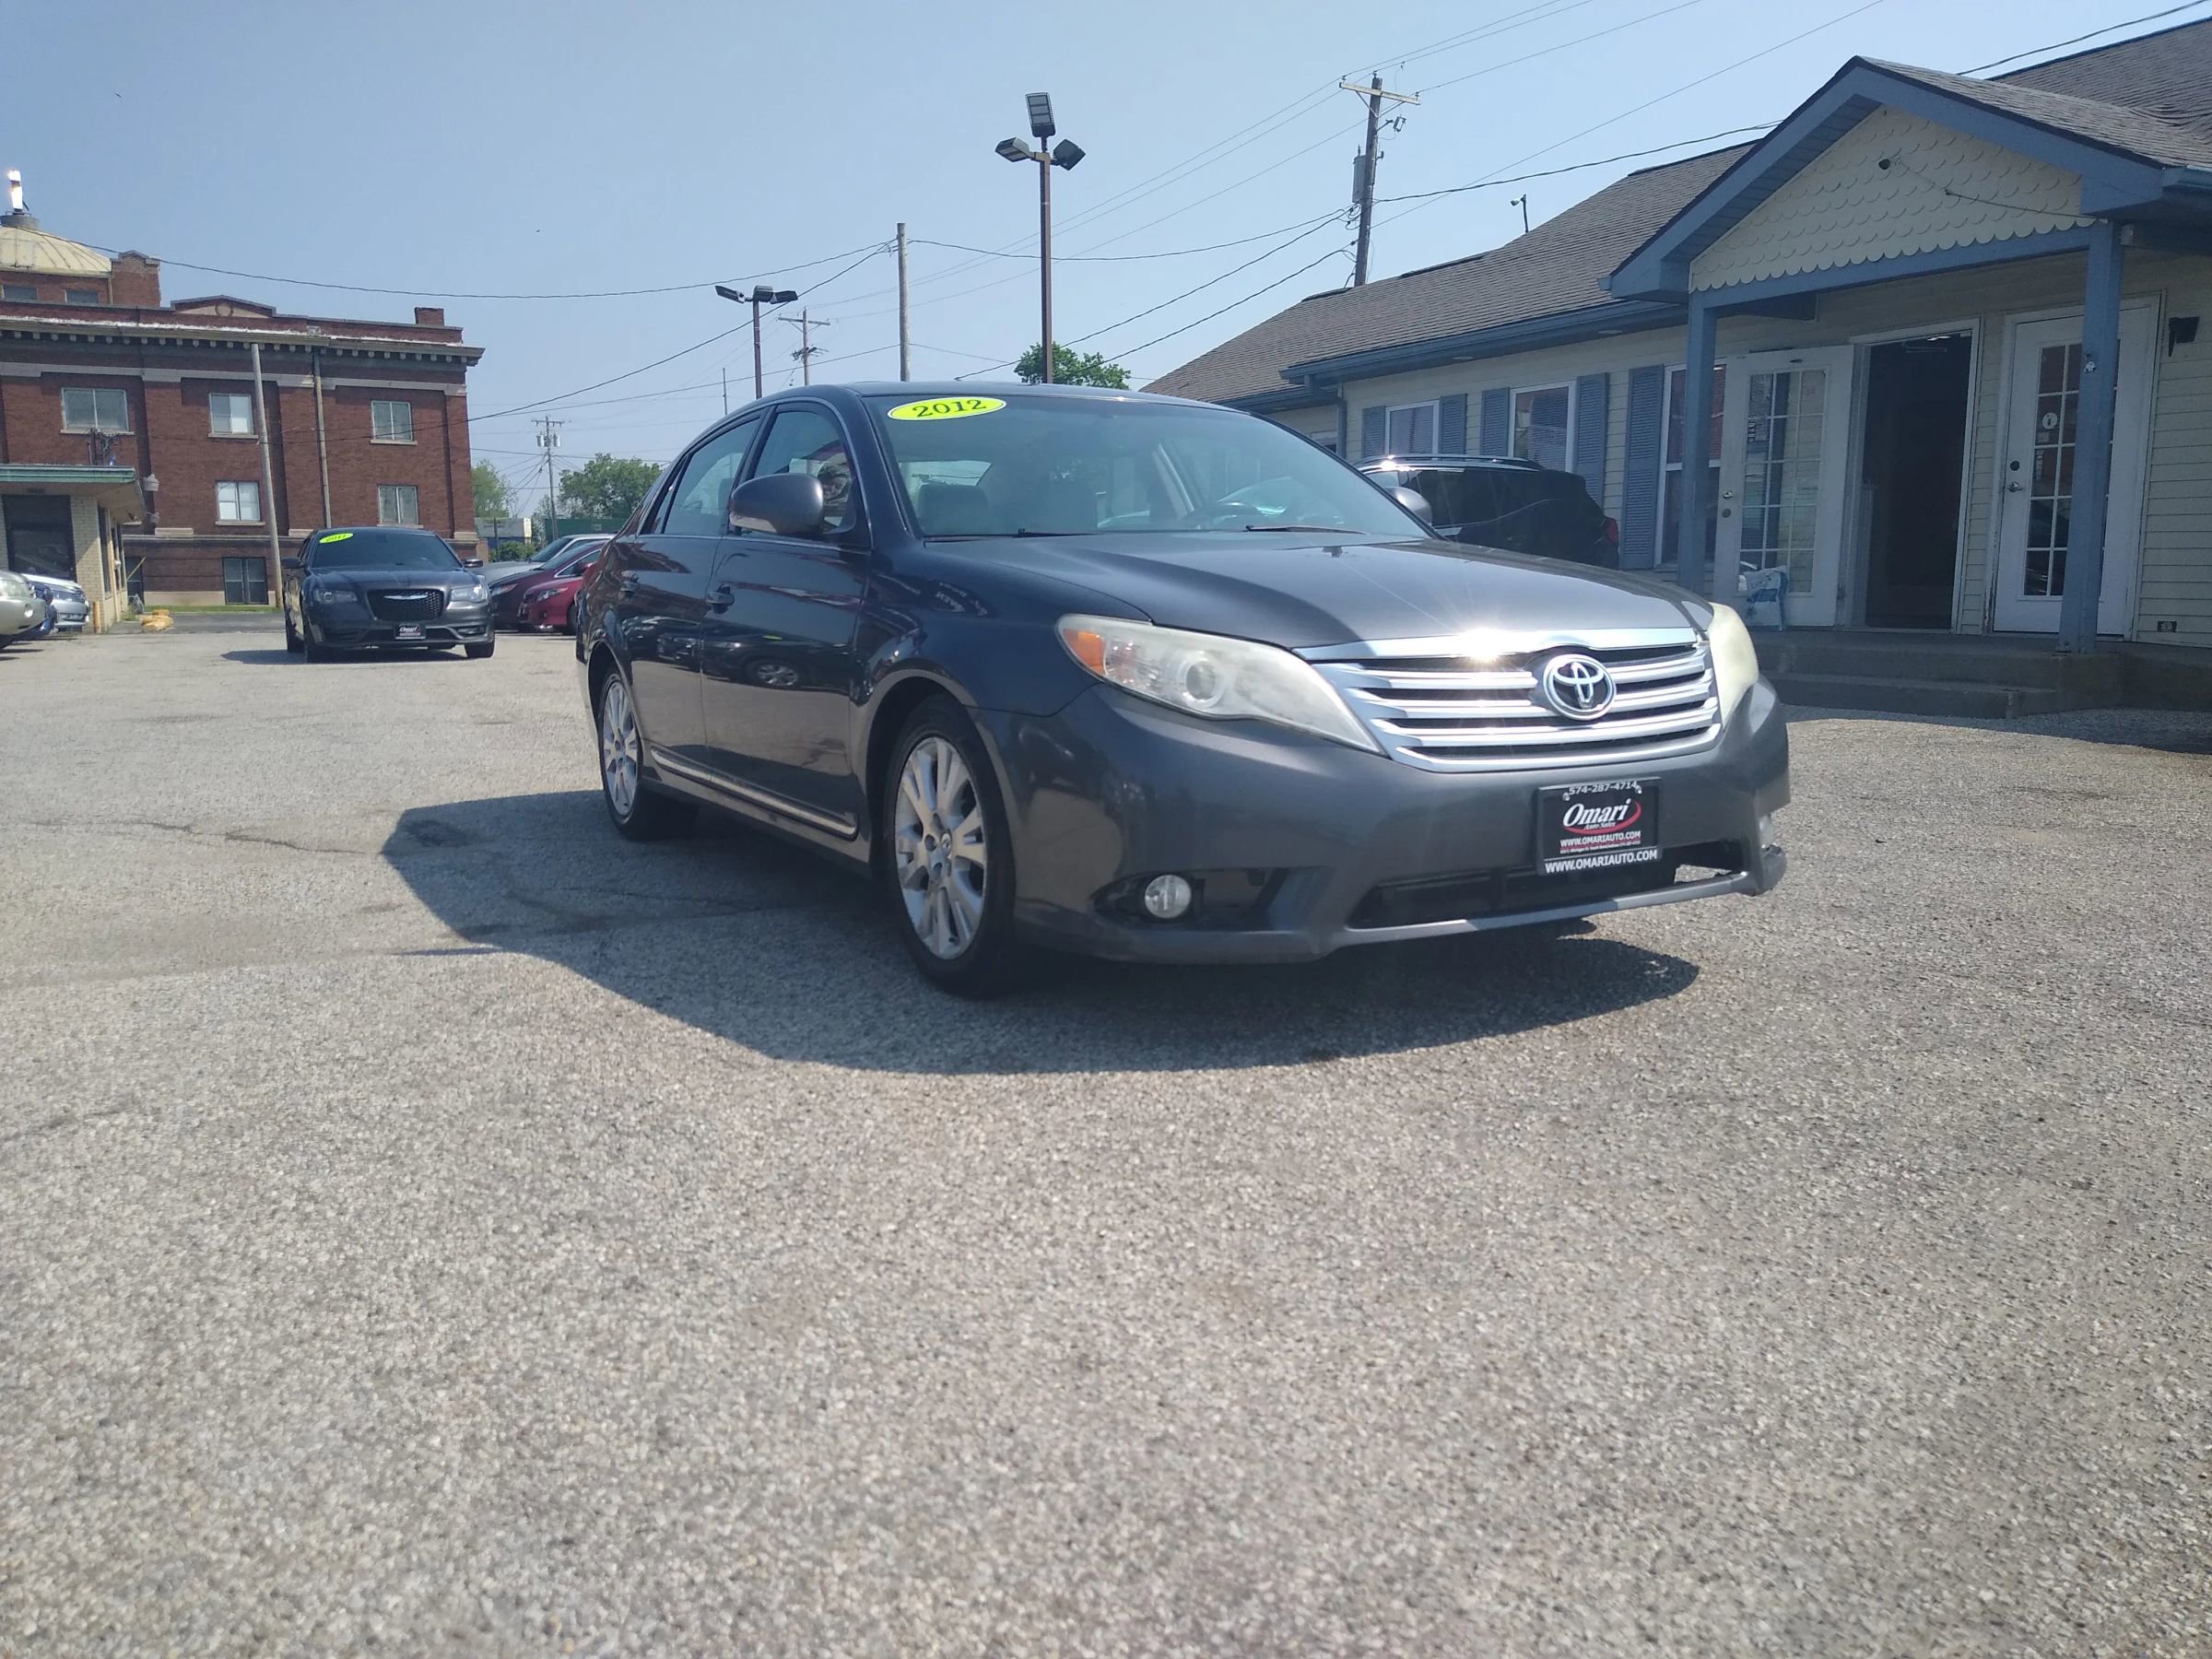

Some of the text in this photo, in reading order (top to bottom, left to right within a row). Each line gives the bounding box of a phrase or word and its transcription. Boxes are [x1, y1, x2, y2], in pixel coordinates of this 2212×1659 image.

[912, 399, 987, 418] 2012
[1569, 781, 1638, 794] 574-287-4714
[1563, 798, 1631, 827] Omari
[1559, 830, 1641, 847] WWW.OMARIAUTO.COM
[1545, 849, 1658, 874] WWW.OMARIAUTO.COM
